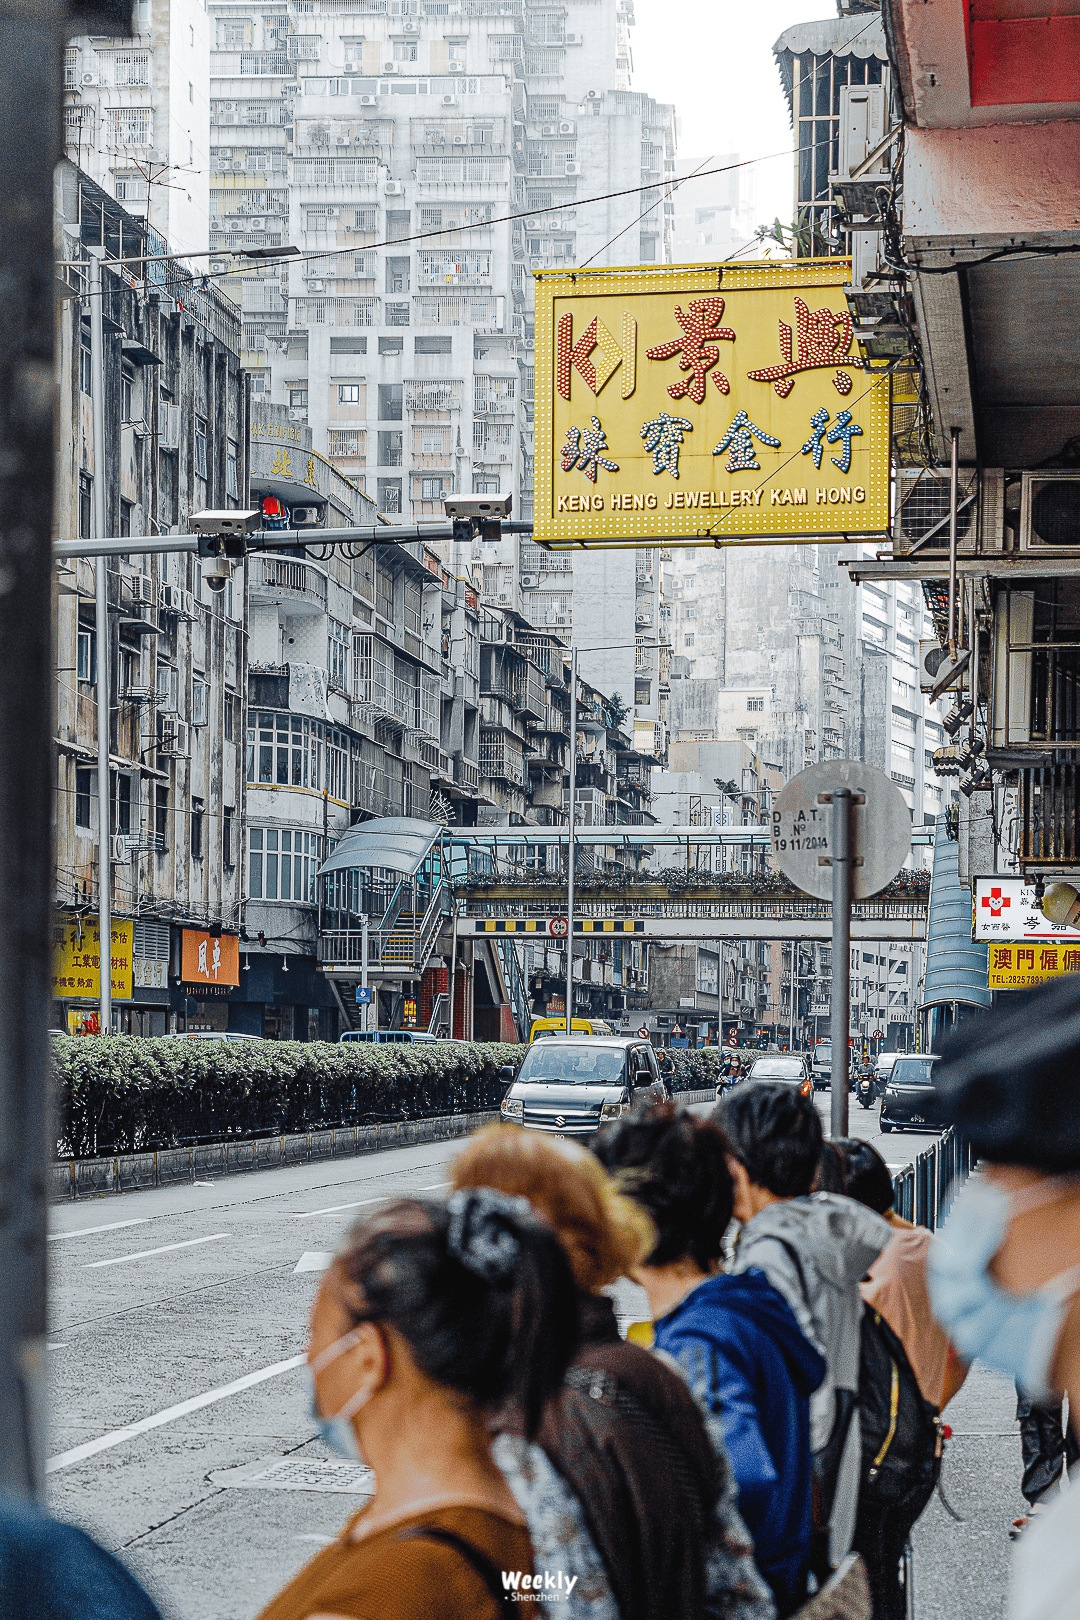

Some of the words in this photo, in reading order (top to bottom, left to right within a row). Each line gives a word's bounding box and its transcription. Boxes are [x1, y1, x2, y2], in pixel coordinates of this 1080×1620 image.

[267, 424, 301, 442] EDIFICIO
[560, 406, 863, 483] 珠寶金行
[557, 494, 604, 512] KENG
[610, 493, 657, 511] HENG
[663, 488, 763, 509] JEWELLERY
[769, 487, 808, 505] KAM
[815, 485, 866, 503] HONG
[71, 953, 129, 971] 工業電材料
